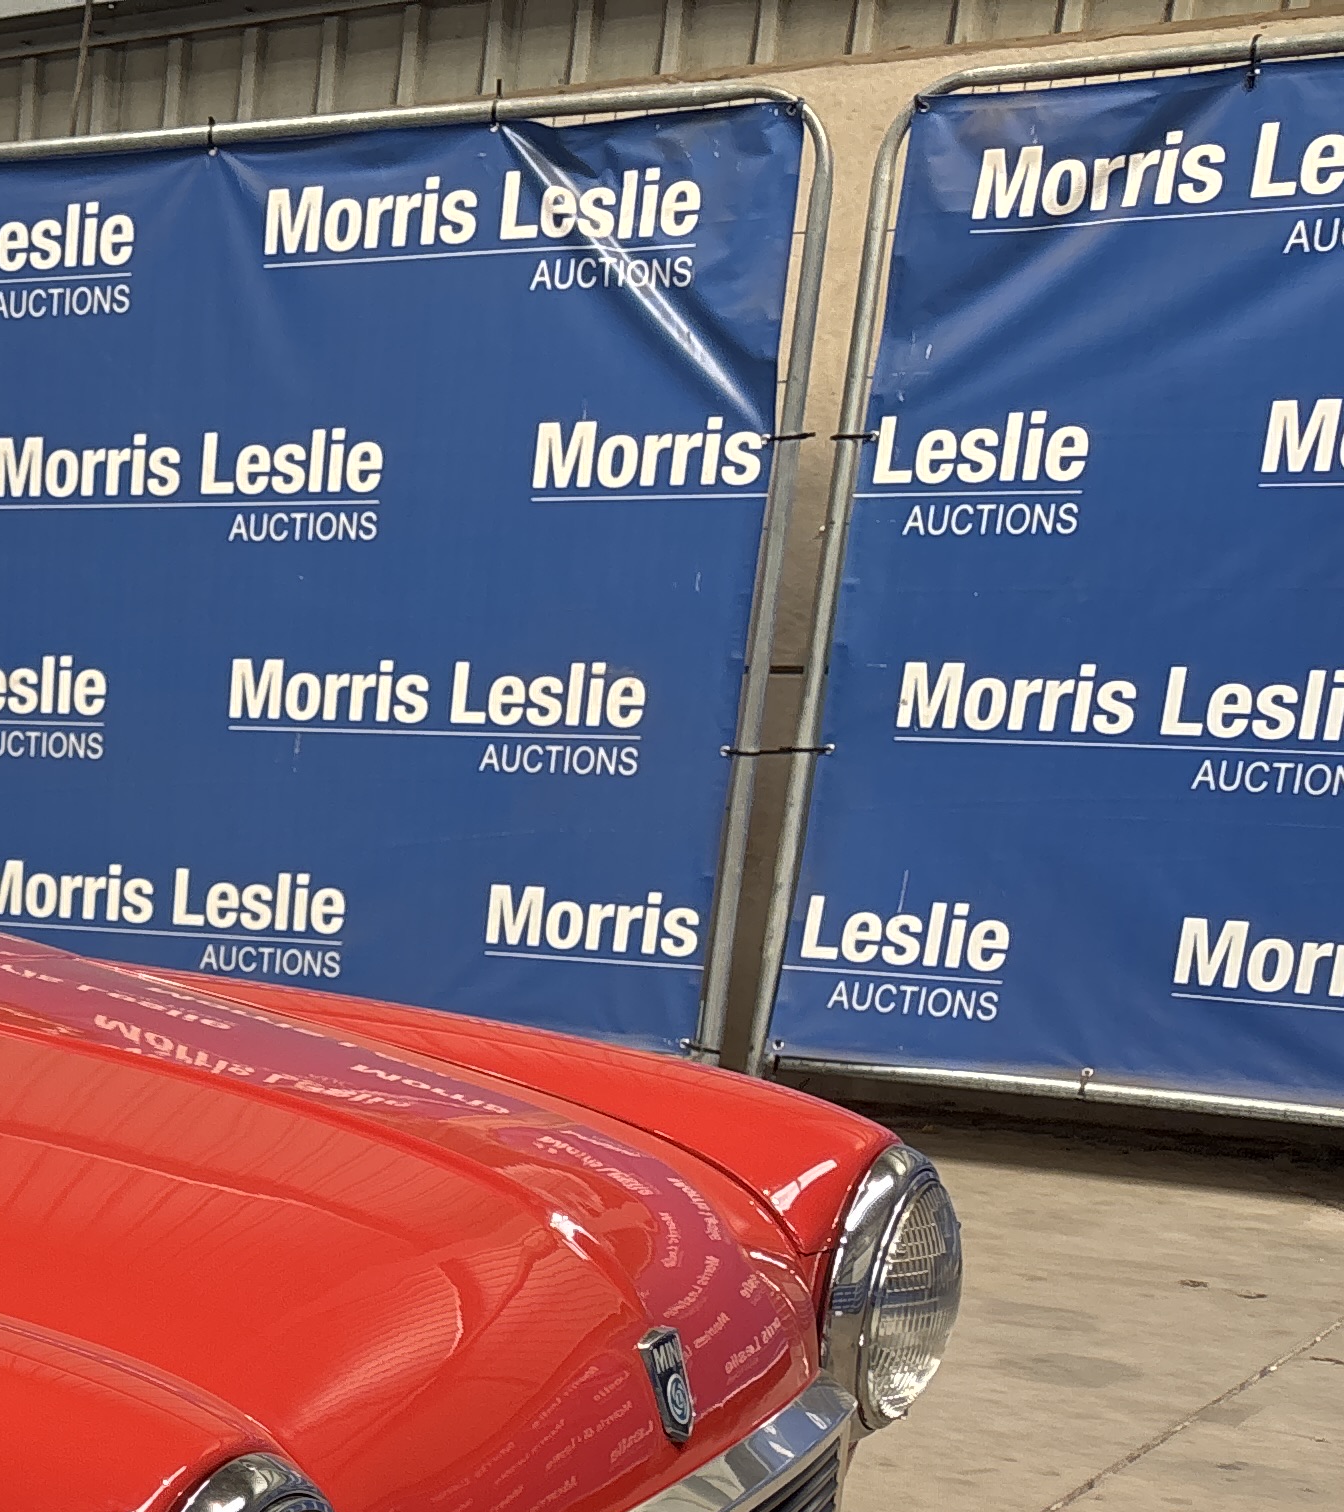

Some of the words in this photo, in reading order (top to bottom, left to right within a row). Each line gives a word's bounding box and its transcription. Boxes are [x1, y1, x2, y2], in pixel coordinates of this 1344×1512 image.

[971, 129, 1226, 220] Morris
[263, 175, 478, 256] Morris
[499, 166, 702, 241] Leslie
[529, 255, 696, 291] AUCTIONS
[200, 427, 384, 495] Leslie
[532, 416, 764, 490] Morris
[869, 410, 1090, 485] Leslie
[228, 510, 378, 542] AUCTIONS
[901, 502, 1079, 536] AUCTIONS
[228, 658, 430, 724] Morris
[449, 660, 646, 729] Leslie
[895, 661, 1137, 735] Morris
[1159, 666, 1344, 742] Lesli
[478, 743, 639, 776] AUCTIONS
[1190, 759, 1344, 796] AUCTION
[172, 867, 346, 935] Leslie
[485, 883, 700, 958] Morris
[800, 894, 1010, 972] Leslie
[199, 943, 341, 978] AUCTIONS
[826, 980, 999, 1022] AUCTIONS
[652, 1338, 682, 1375] MIN
